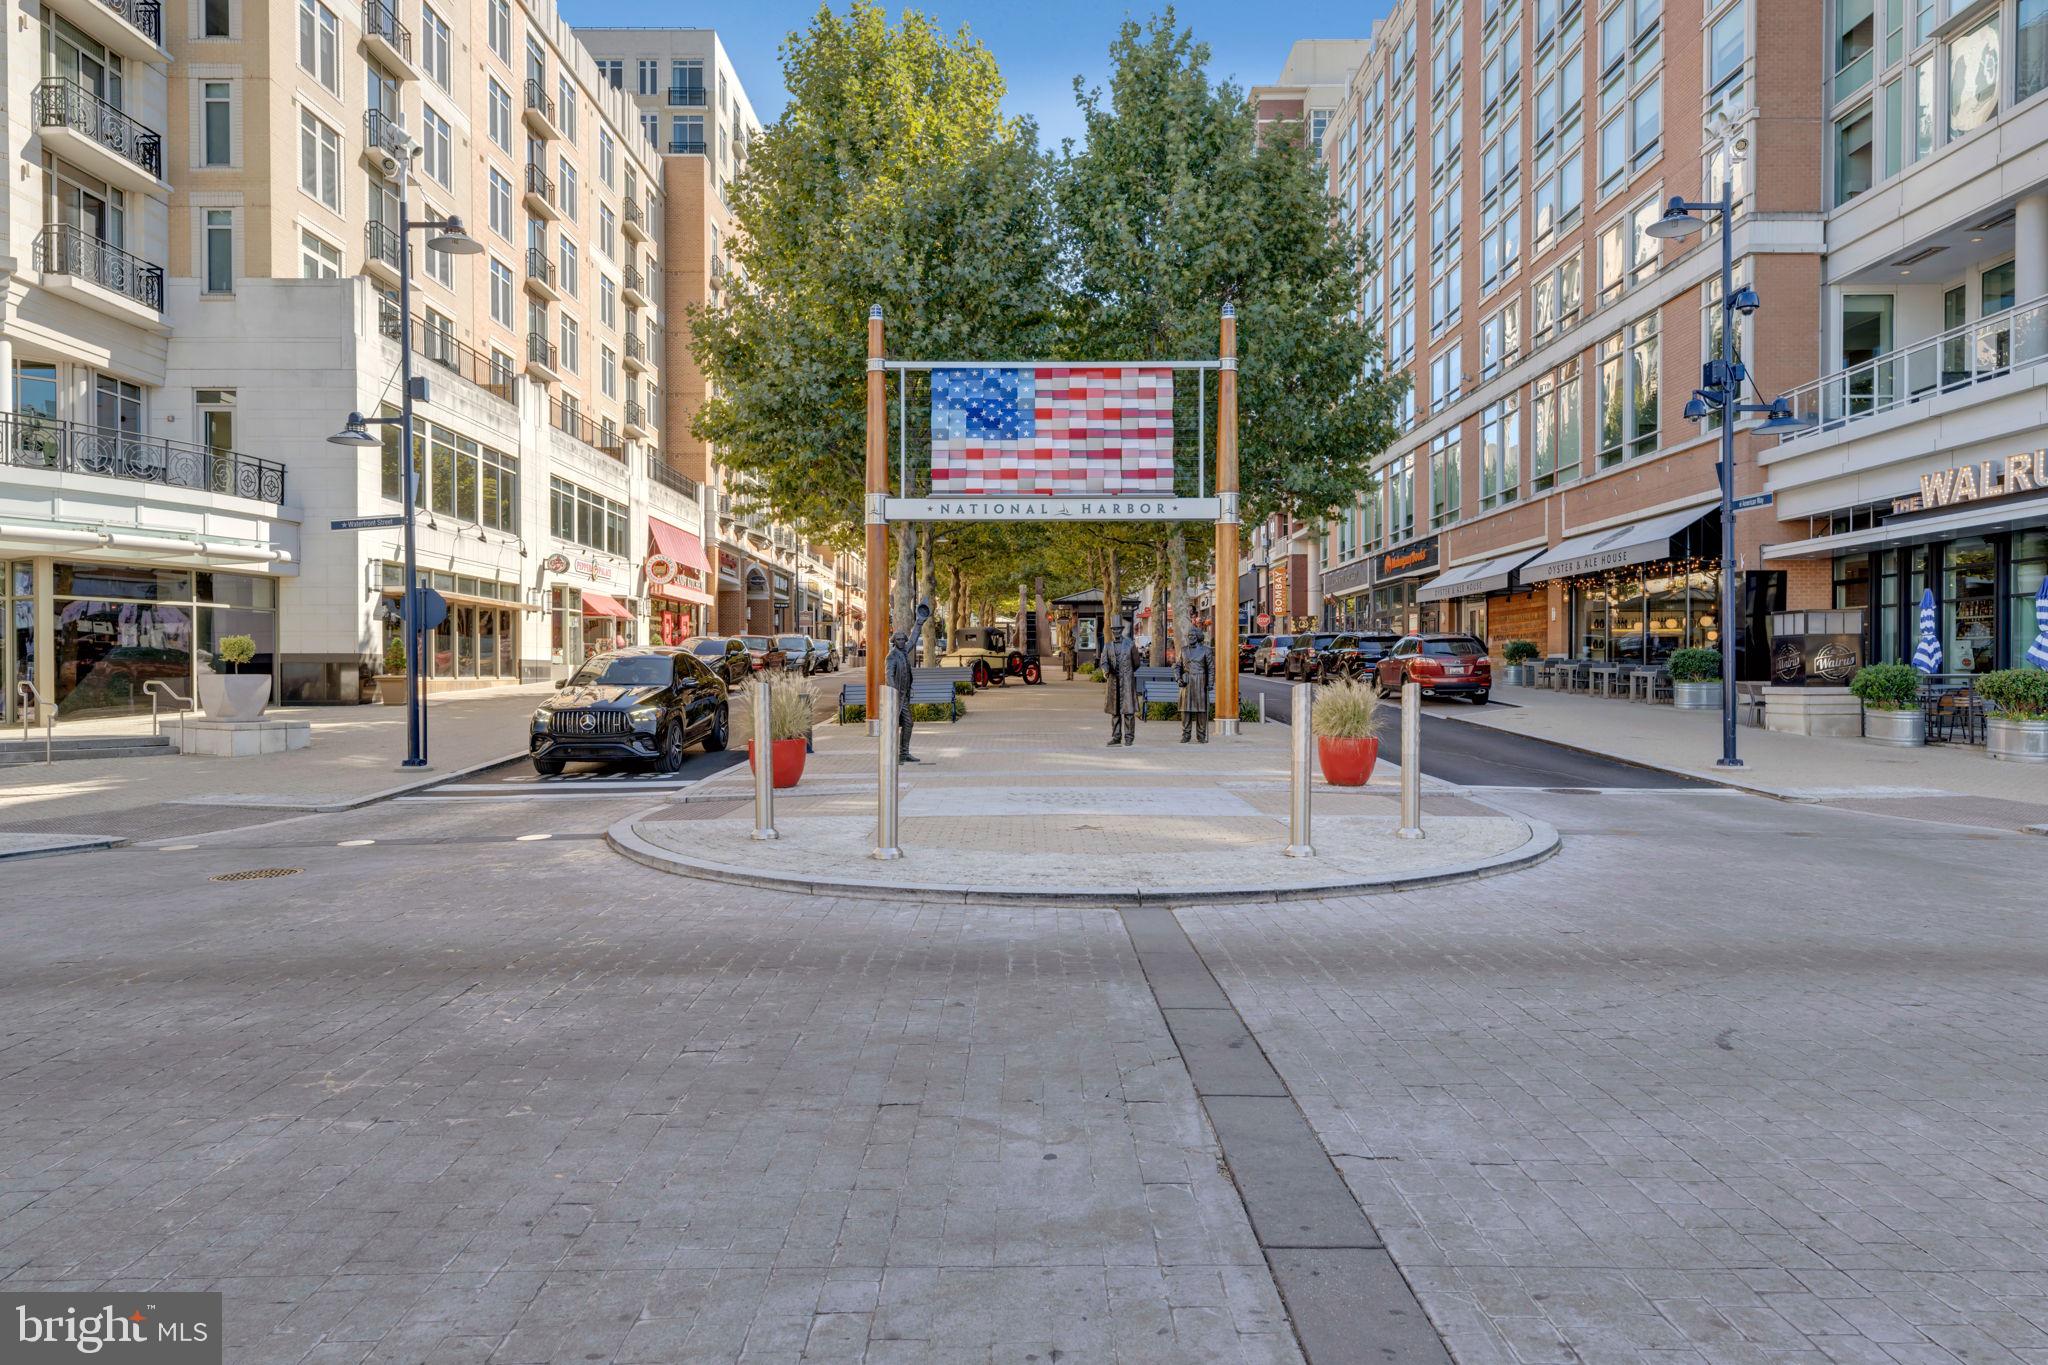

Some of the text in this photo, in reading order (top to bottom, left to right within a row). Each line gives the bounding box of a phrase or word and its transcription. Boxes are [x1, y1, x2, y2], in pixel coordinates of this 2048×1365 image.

[940, 503, 1166, 515] NATIONAL HARBOR
[1891, 497, 1922, 515] THE
[347, 518, 393, 529] Waterfront Street
[1547, 562, 1573, 575] OYSTER
[1584, 557, 1598, 569] ALE
[1601, 551, 1628, 567] HOUSE
[1274, 571, 1283, 613] BOMBAY
[1434, 587, 1450, 598] OYSTER
[1456, 584, 1465, 593] ALE
[1466, 581, 1482, 592] HOUSE
[1816, 656, 1855, 670] Walrus
